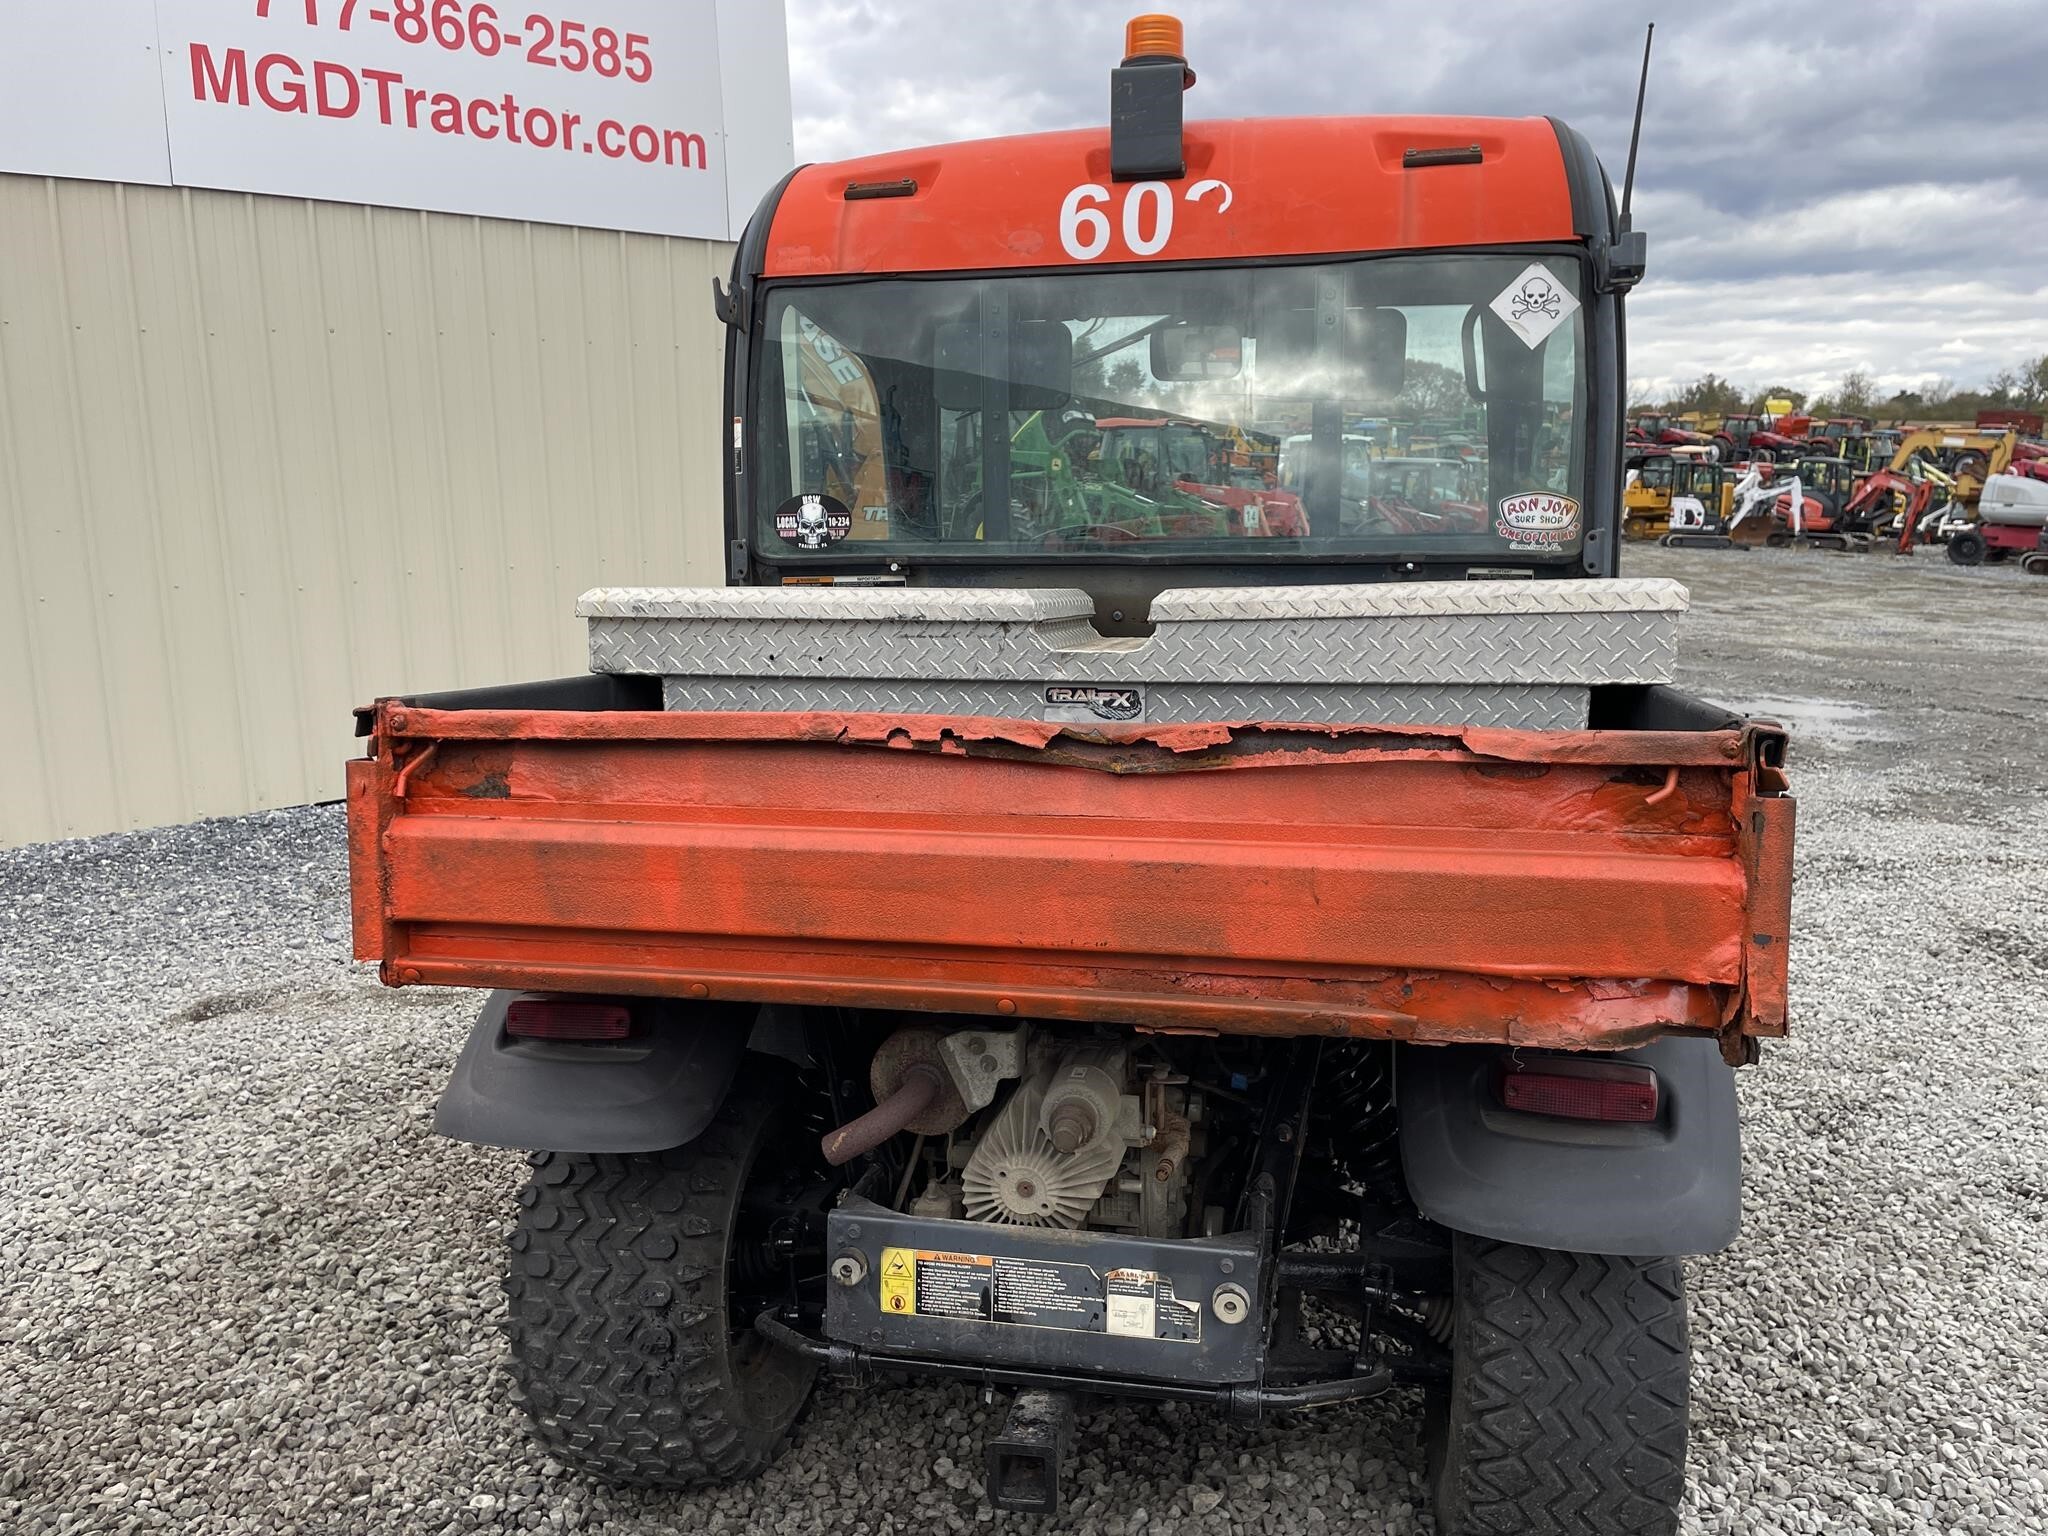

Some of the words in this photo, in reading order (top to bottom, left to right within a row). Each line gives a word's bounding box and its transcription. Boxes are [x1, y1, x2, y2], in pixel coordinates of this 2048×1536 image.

[189, 42, 708, 170] MGDTractor.com
[801, 494, 821, 505] USW
[1507, 498, 1539, 517] RON
[1541, 499, 1574, 517] JON
[776, 516, 798, 529] LOCAL
[827, 516, 850, 528] 10-234
[1514, 515, 1536, 524] SURF
[1539, 515, 1564, 525] SHOP
[1499, 527, 1523, 542] ONE
[1522, 531, 1539, 543] OF
[1539, 530, 1549, 542] A
[1549, 528, 1577, 542] KIND
[941, 1253, 976, 1264] WARNING
